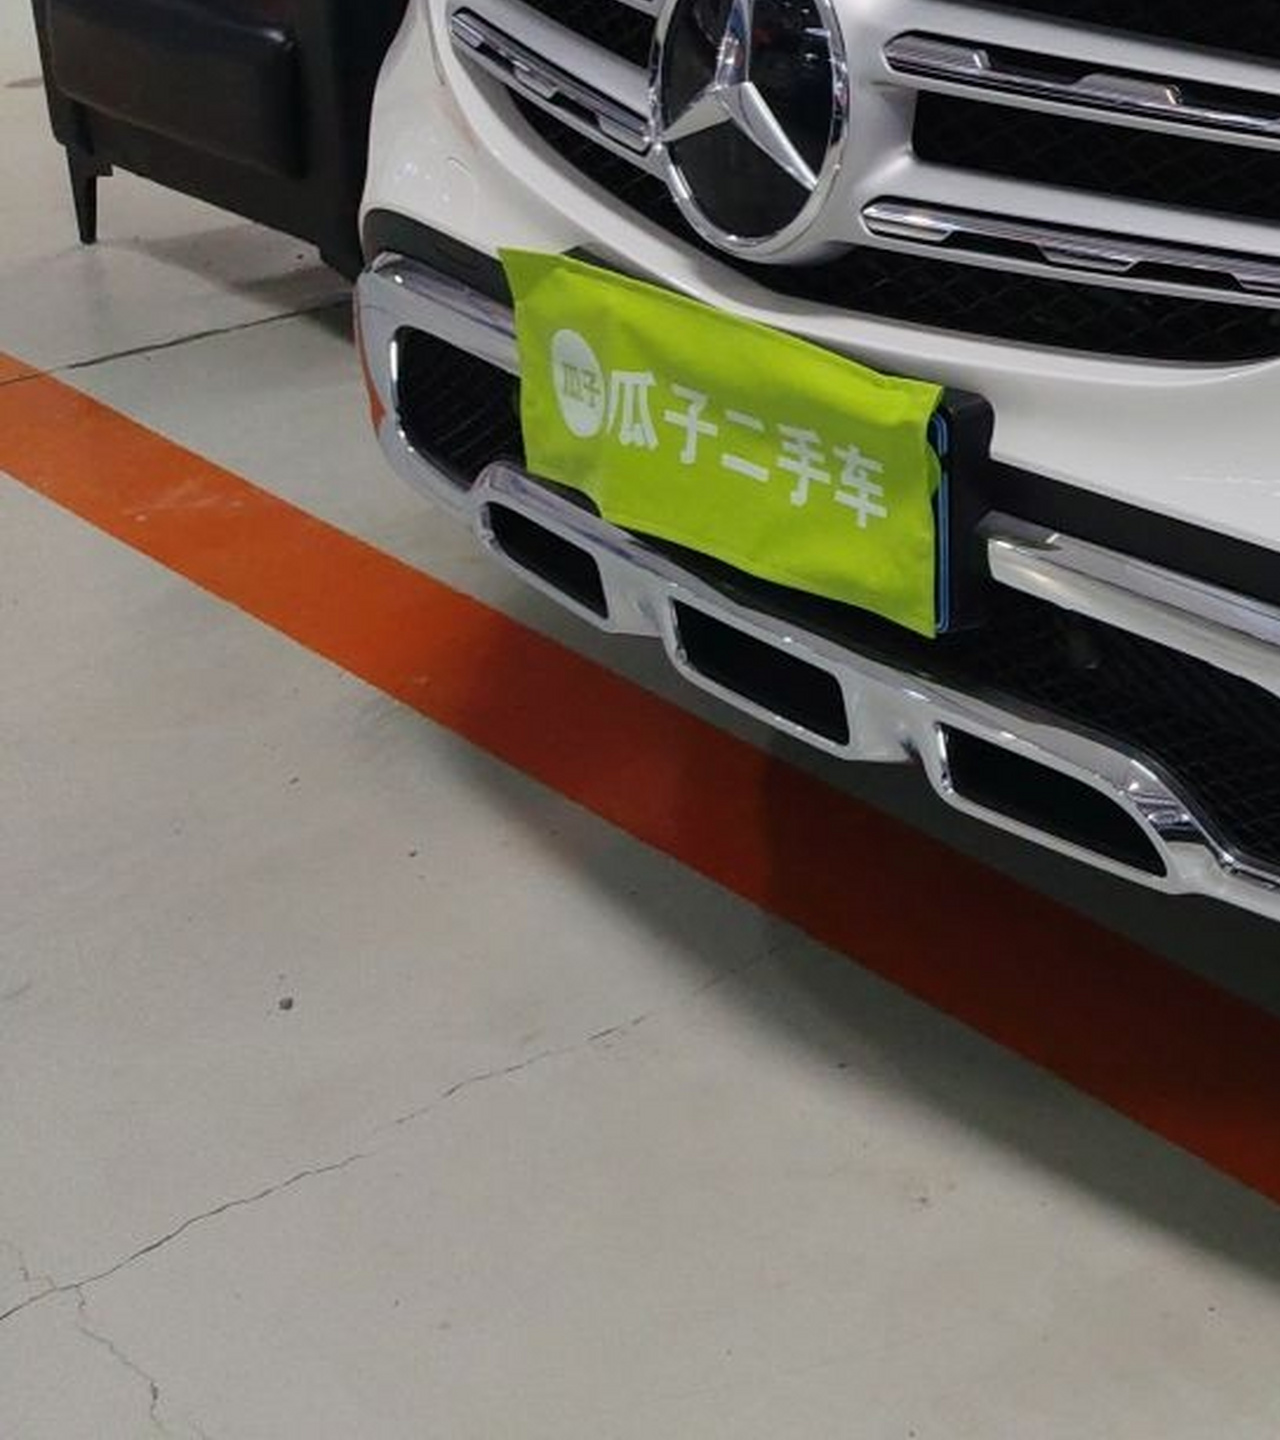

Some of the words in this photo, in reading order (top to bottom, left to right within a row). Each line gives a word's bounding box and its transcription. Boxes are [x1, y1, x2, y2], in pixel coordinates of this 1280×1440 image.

[606, 370, 888, 529] 瓜子二手车
